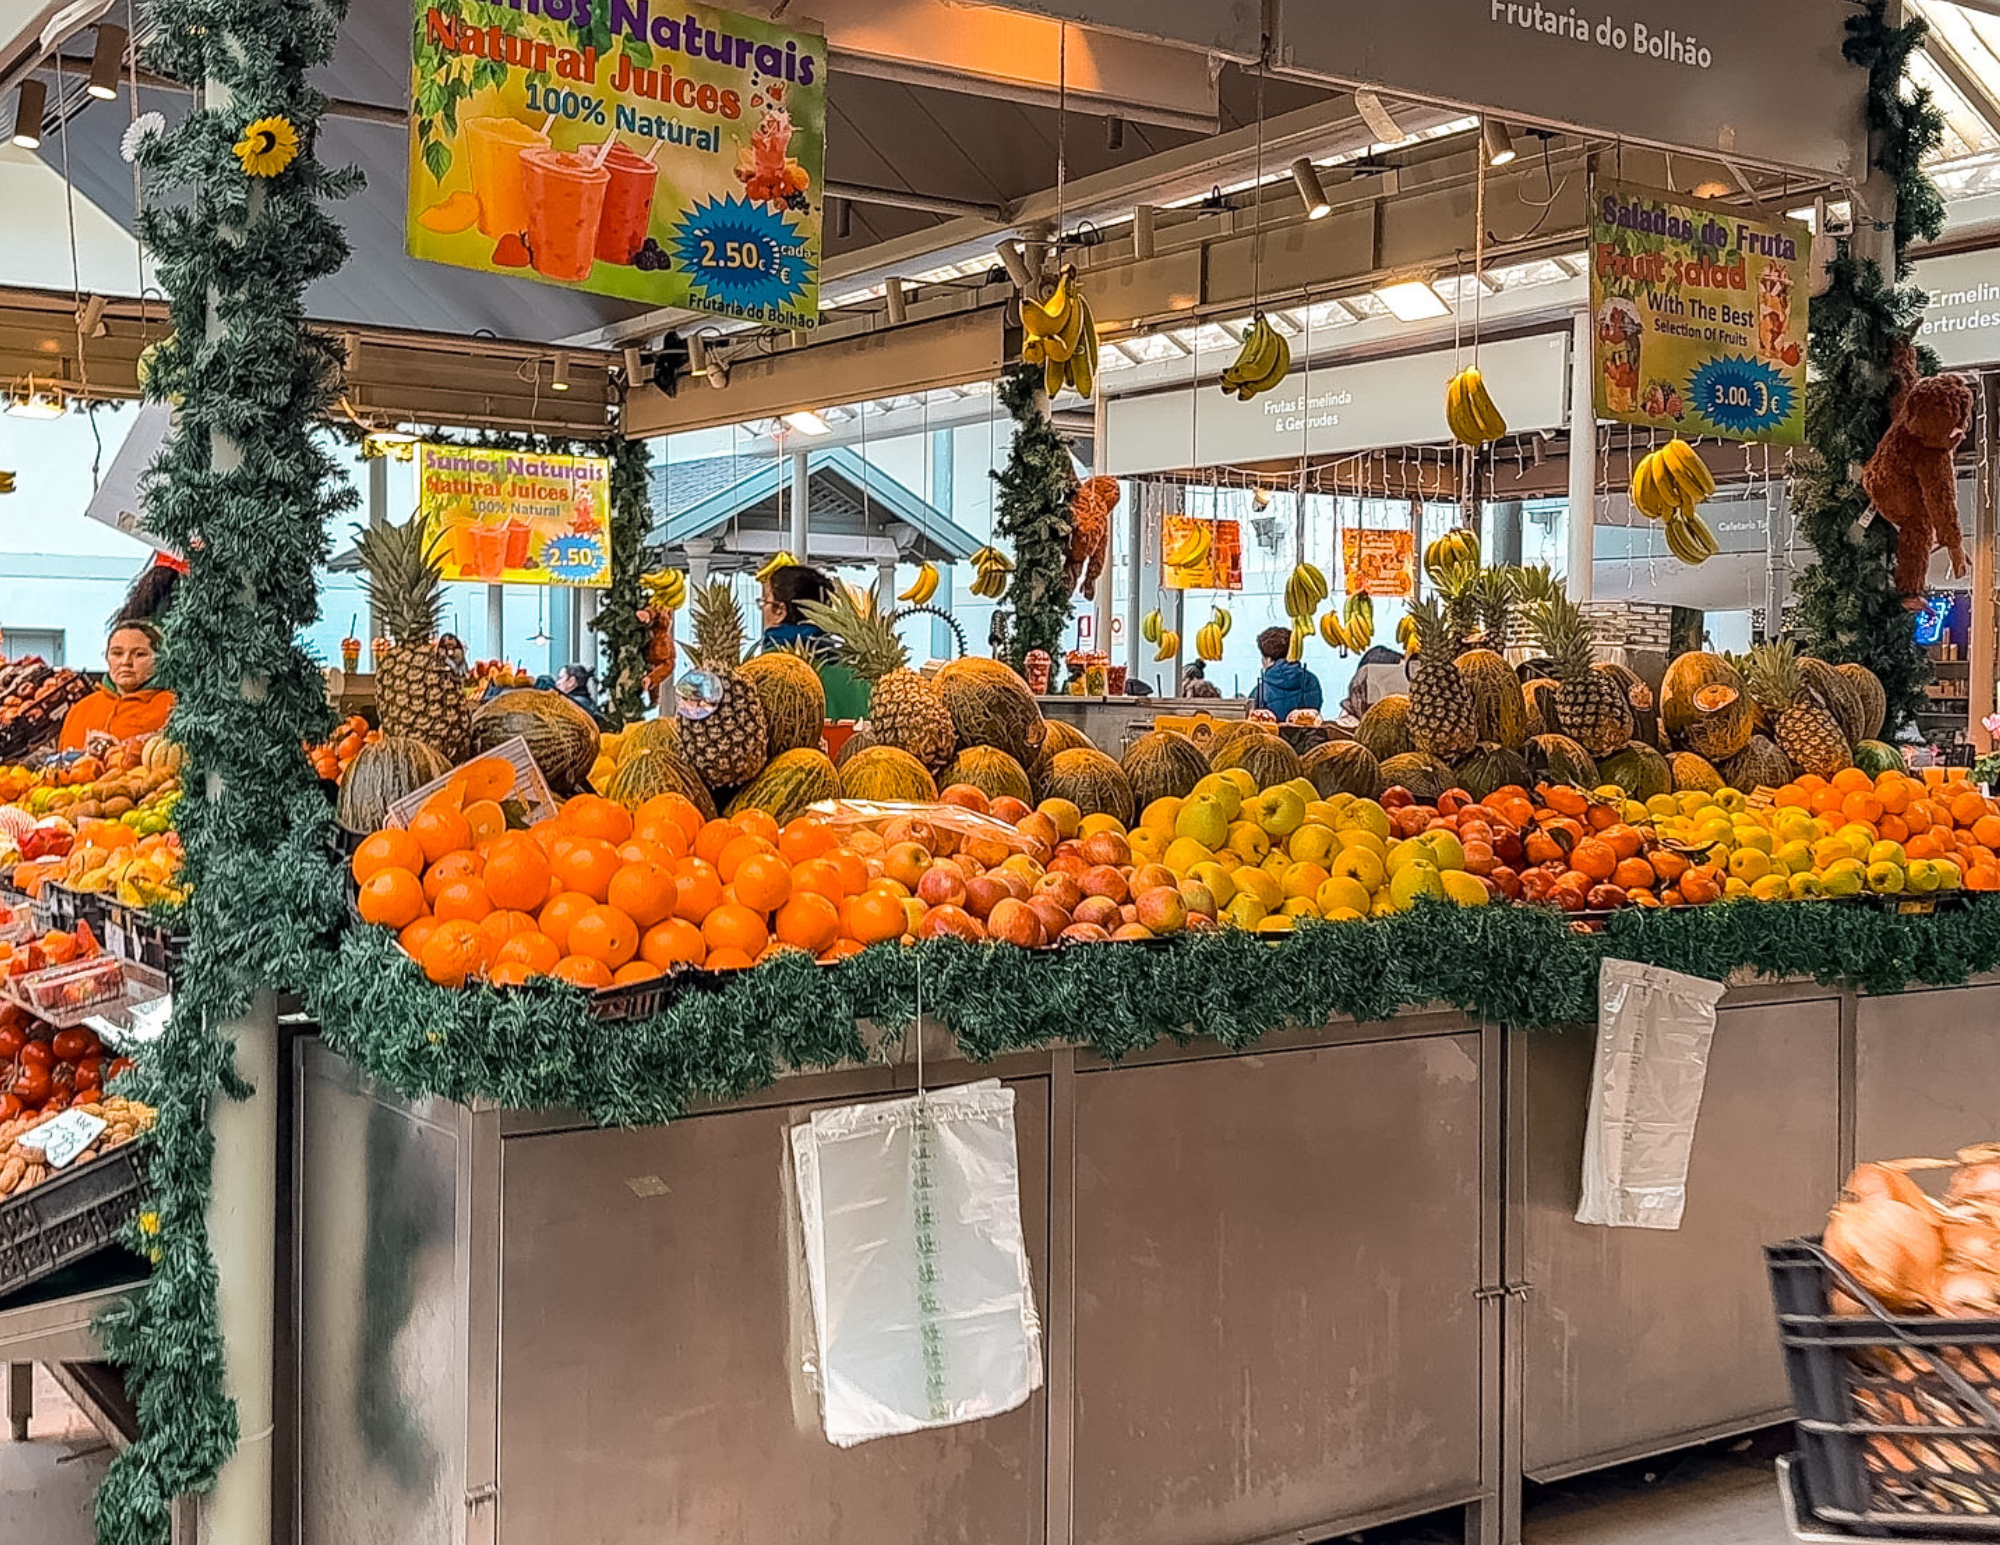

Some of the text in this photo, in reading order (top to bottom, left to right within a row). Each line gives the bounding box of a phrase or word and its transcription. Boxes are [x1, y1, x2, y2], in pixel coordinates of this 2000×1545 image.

[609, 0, 815, 86] Naturais
[1491, 0, 1712, 68] Frutaria do Bolhão
[427, 7, 742, 120] Natural Juices
[525, 83, 720, 153] 100% Natural
[1603, 195, 1796, 261] Saladas de Fruta
[1597, 244, 1747, 291] Fruit salad
[689, 294, 815, 329] Frutaria do Bolhão
[1648, 292, 1755, 328] With The Best
[1917, 309, 2000, 336] ertrudes
[1654, 317, 1748, 347] Selection Of Fruits
[1264, 400, 1296, 415] Frutas
[1275, 418, 1284, 432] &
[426, 450, 603, 481] Sumos Naturais
[426, 475, 502, 496] Natural
[472, 500, 560, 517] 100% Natural
